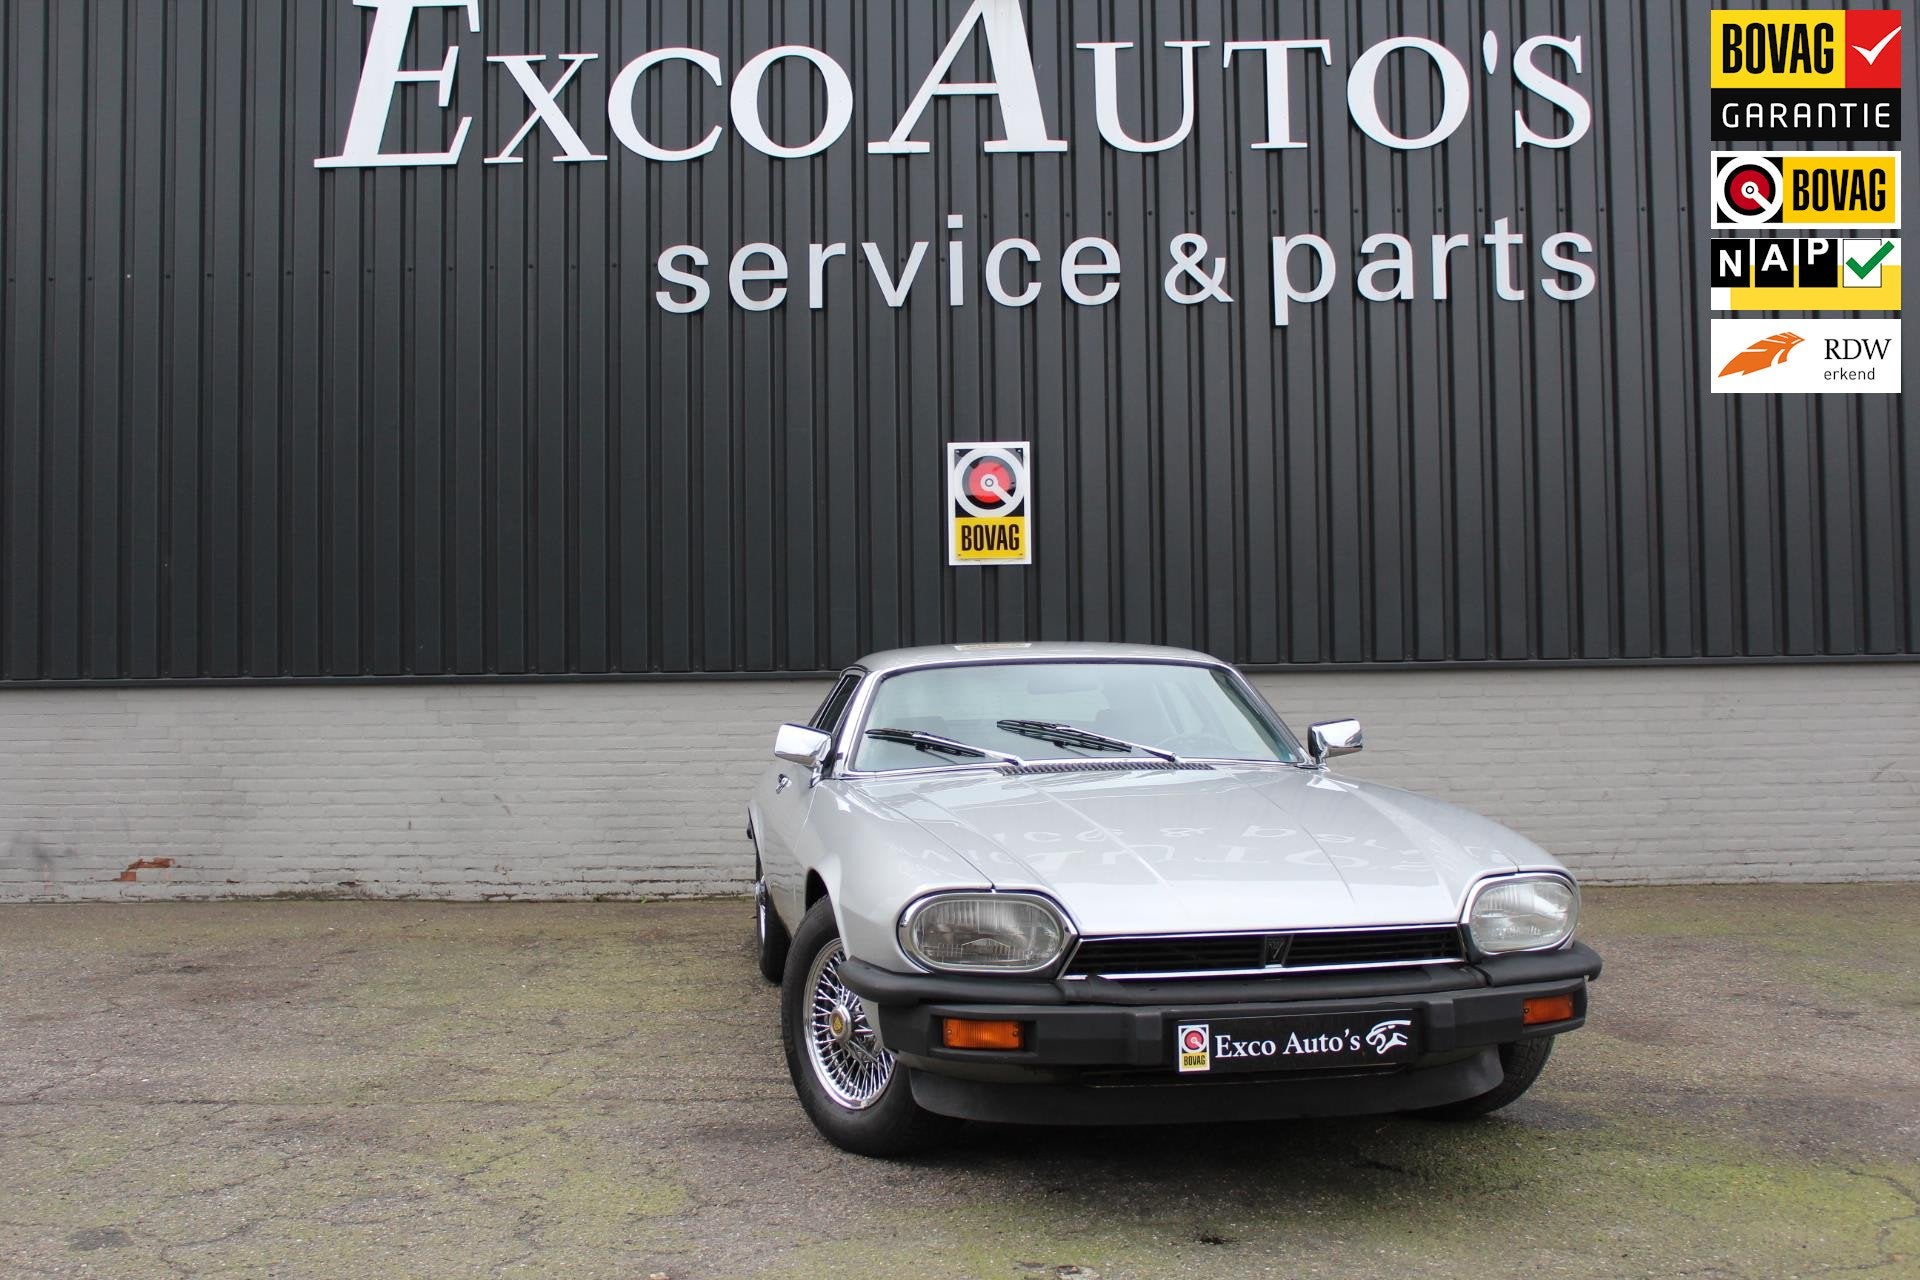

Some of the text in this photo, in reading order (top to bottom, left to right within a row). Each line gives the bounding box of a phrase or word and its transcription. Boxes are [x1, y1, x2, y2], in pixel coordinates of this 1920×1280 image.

[656, 214, 1597, 326] service & parts
[961, 523, 1020, 552] BOVAG
[1214, 1028, 1361, 1058] Exco Auto's
[1183, 1054, 1206, 1066] BOVAG
